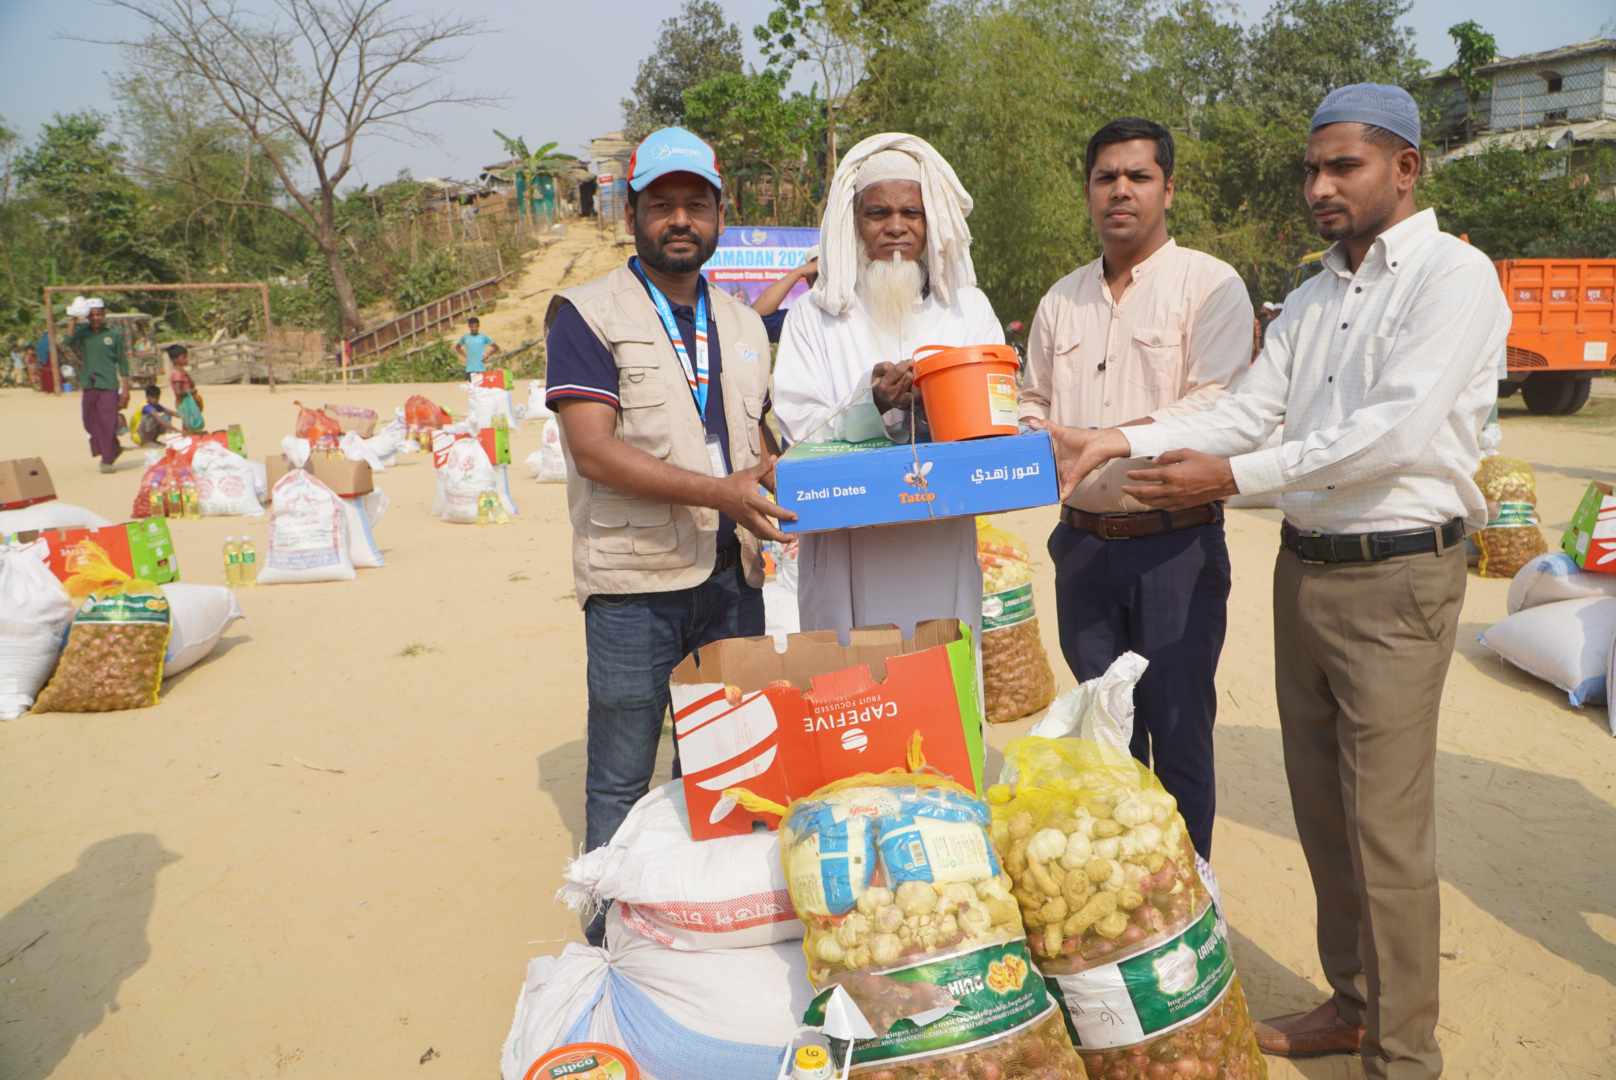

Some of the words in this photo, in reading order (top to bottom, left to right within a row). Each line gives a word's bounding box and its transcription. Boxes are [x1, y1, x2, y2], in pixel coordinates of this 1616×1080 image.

[704, 250, 774, 267] AMADAN
[778, 250, 807, 267] 202
[970, 465, 1009, 485] زهدي
[1011, 461, 1041, 481] تمور
[796, 487, 830, 502] Zahdi
[832, 485, 866, 497] Dates
[814, 700, 857, 714] FOCUSSED
[858, 693, 881, 705] FRUIT
[802, 700, 898, 732] CAPEFIVE
[553, 1057, 593, 1076] Sipco
